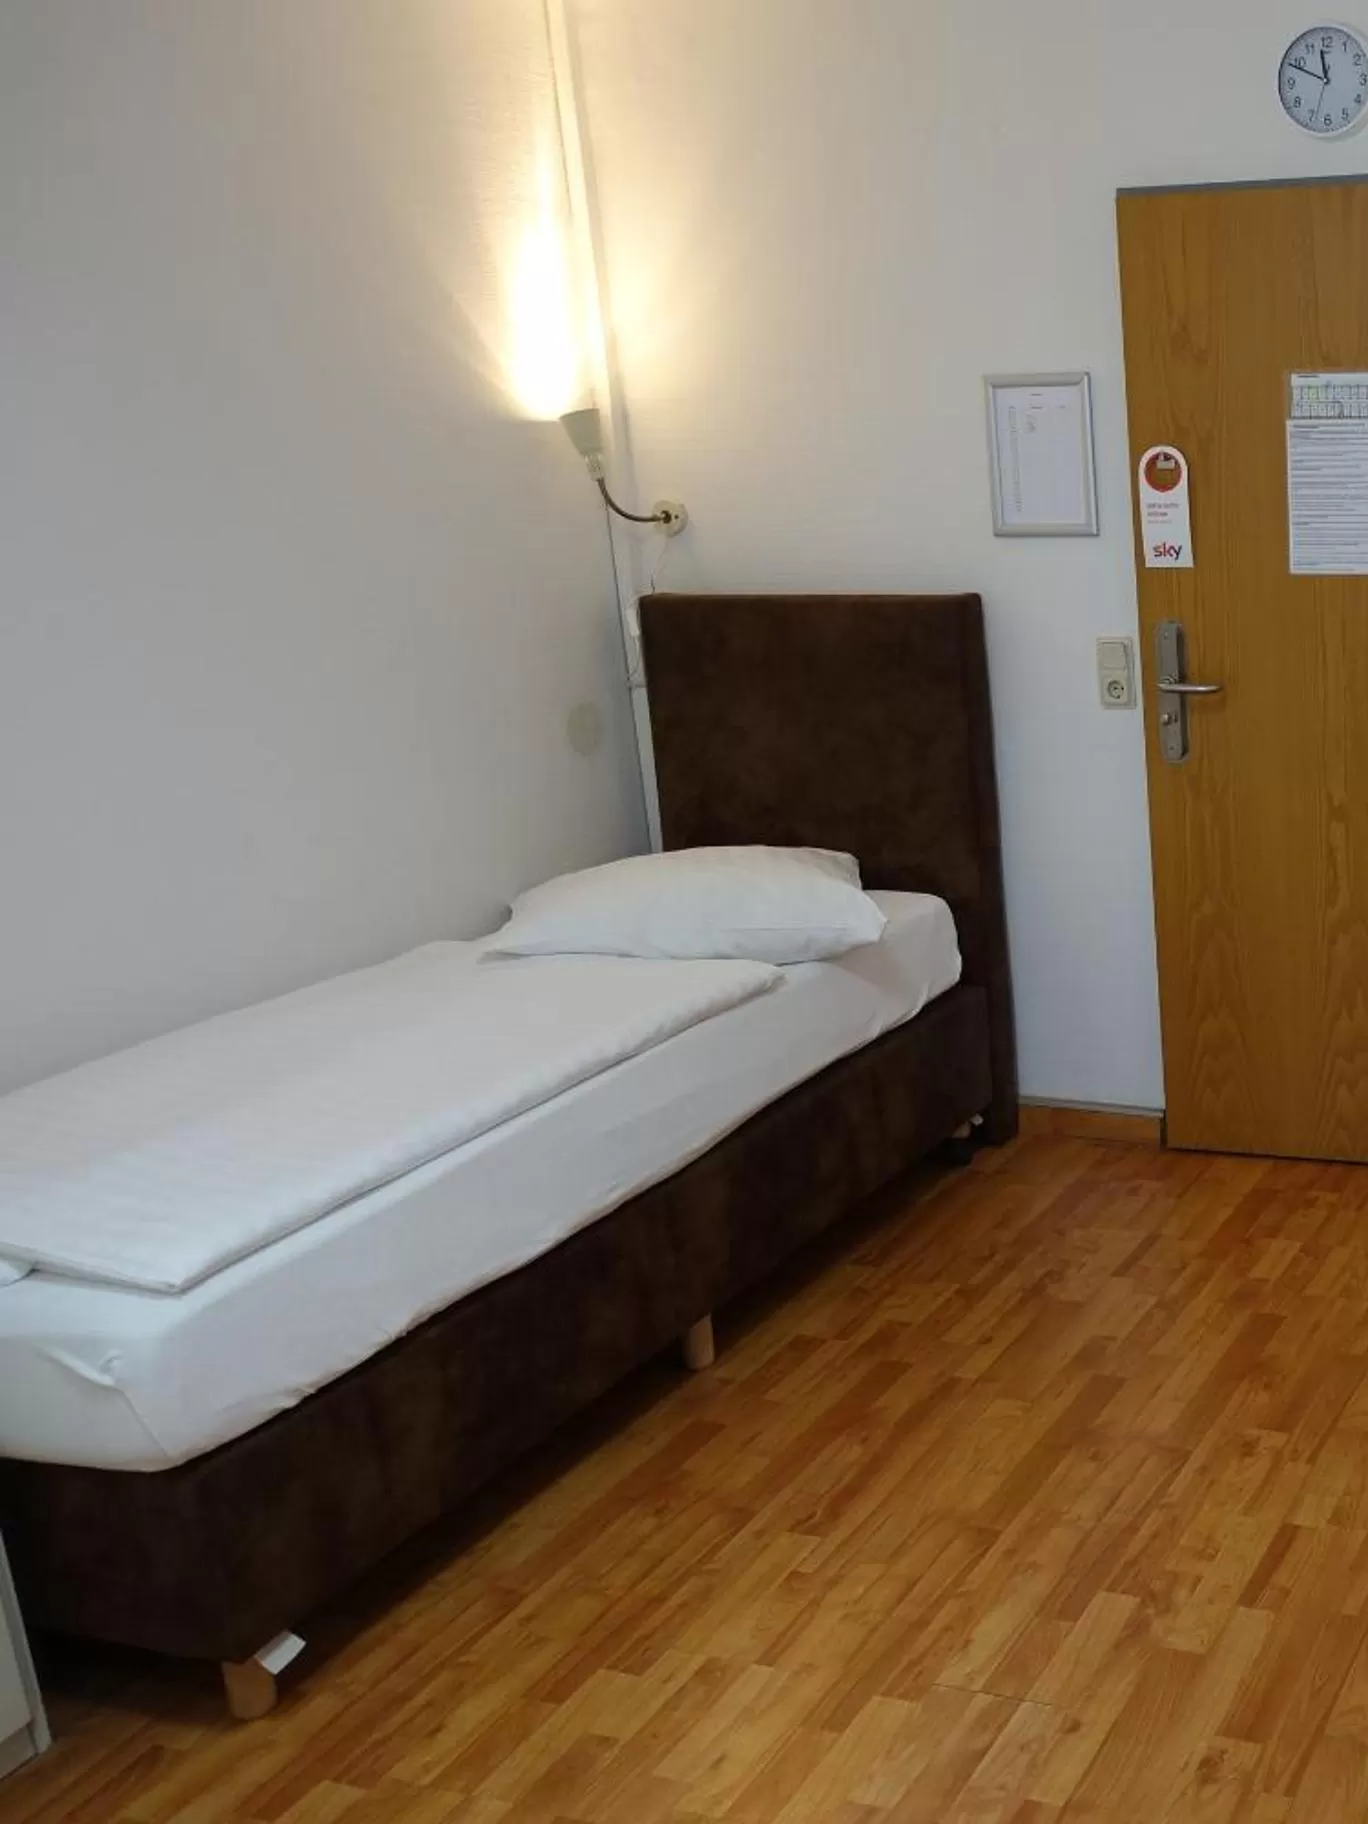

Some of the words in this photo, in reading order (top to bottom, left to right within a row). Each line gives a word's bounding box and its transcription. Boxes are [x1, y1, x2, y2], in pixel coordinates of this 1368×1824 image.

[1320, 36, 1333, 48] 12
[1305, 43, 1315, 54] 11
[1294, 56, 1306, 68] 10
[1353, 53, 1362, 66] 2
[1287, 77, 1295, 90] 9
[1359, 73, 1367, 86] 3
[1293, 96, 1301, 108] 8
[1354, 94, 1361, 104] 4
[1308, 109, 1314, 122] 7
[1323, 114, 1332, 126] 6
[1341, 108, 1349, 121] 5
[1153, 541, 1182, 561] sky
